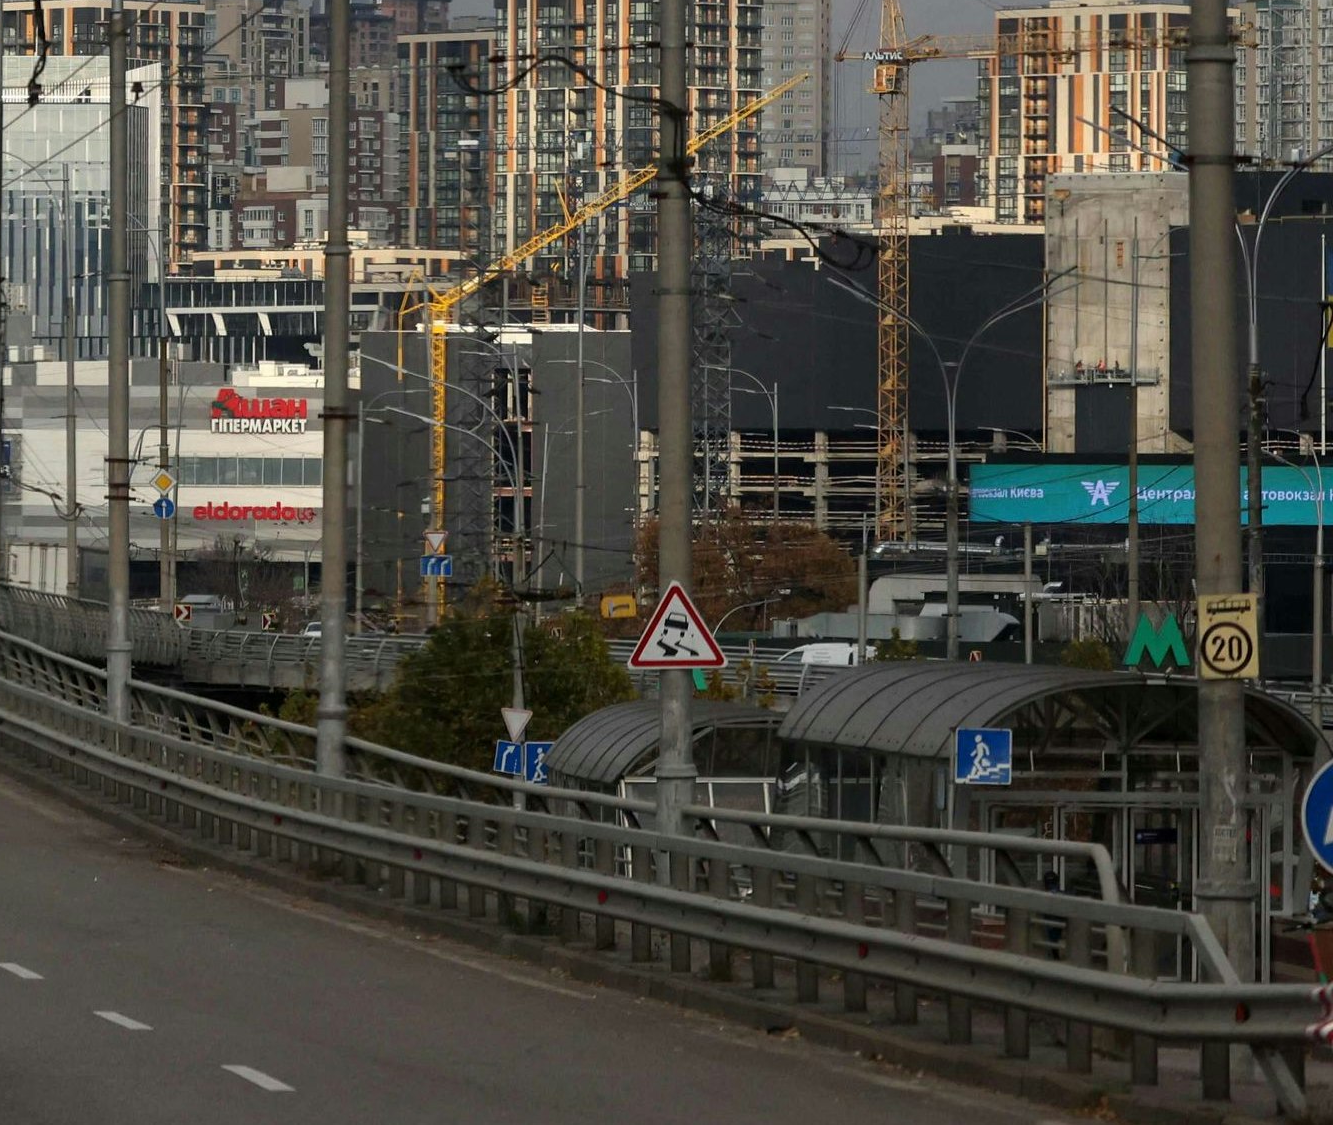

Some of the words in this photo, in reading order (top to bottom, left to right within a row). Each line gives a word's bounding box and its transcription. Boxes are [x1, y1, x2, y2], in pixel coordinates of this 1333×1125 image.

[864, 51, 903, 60] АЛЬТИС
[211, 418, 307, 434] ГІПЕРМАРКЕТ
[1010, 487, 1044, 498] Києва
[1244, 489, 1325, 501] атовокзал
[1212, 635, 1242, 662] 20
